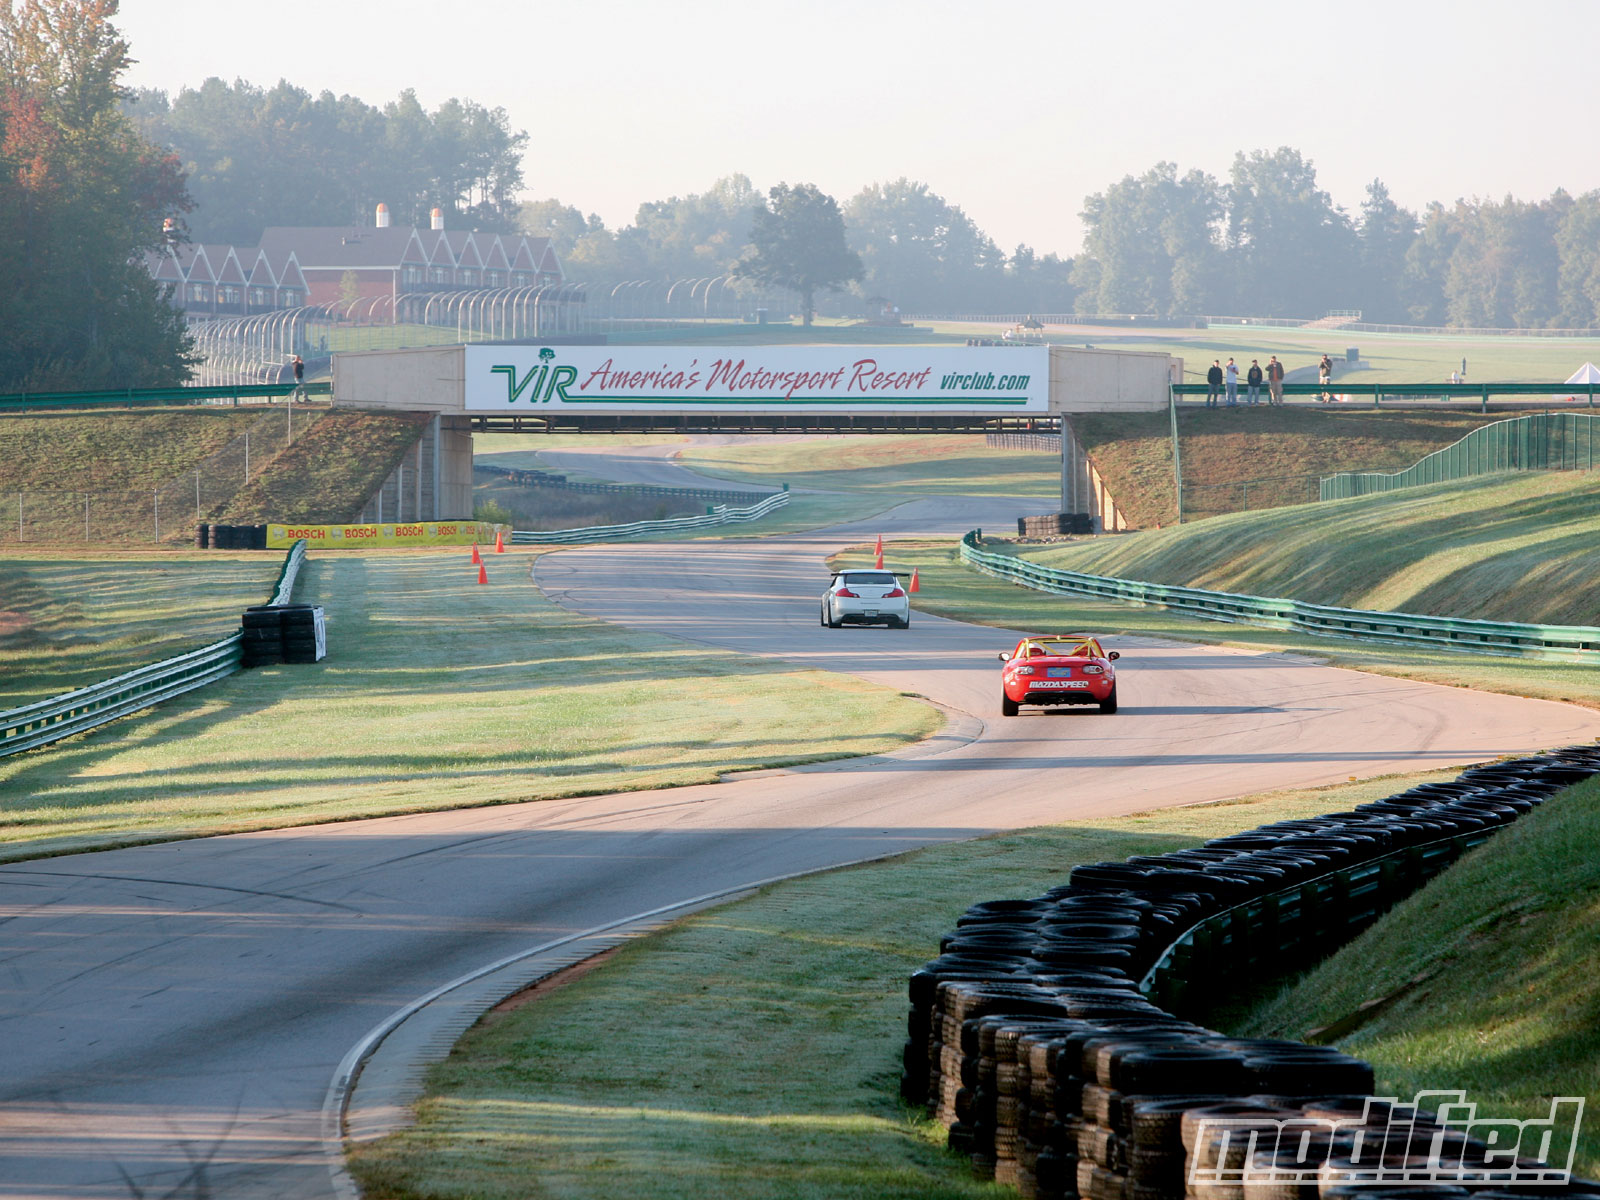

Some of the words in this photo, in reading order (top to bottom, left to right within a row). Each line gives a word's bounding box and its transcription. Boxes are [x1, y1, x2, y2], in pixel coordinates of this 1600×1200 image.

[490, 365, 578, 403] VIR
[580, 358, 702, 391] America's
[705, 358, 845, 400] Motorsport
[847, 358, 932, 392] Resort
[940, 372, 1030, 390] virclub.com
[287, 529, 325, 539] BOSCH
[344, 528, 377, 539] BOSCH
[395, 526, 424, 537] BOSCH
[1029, 680, 1089, 688] MAZDASPEED
